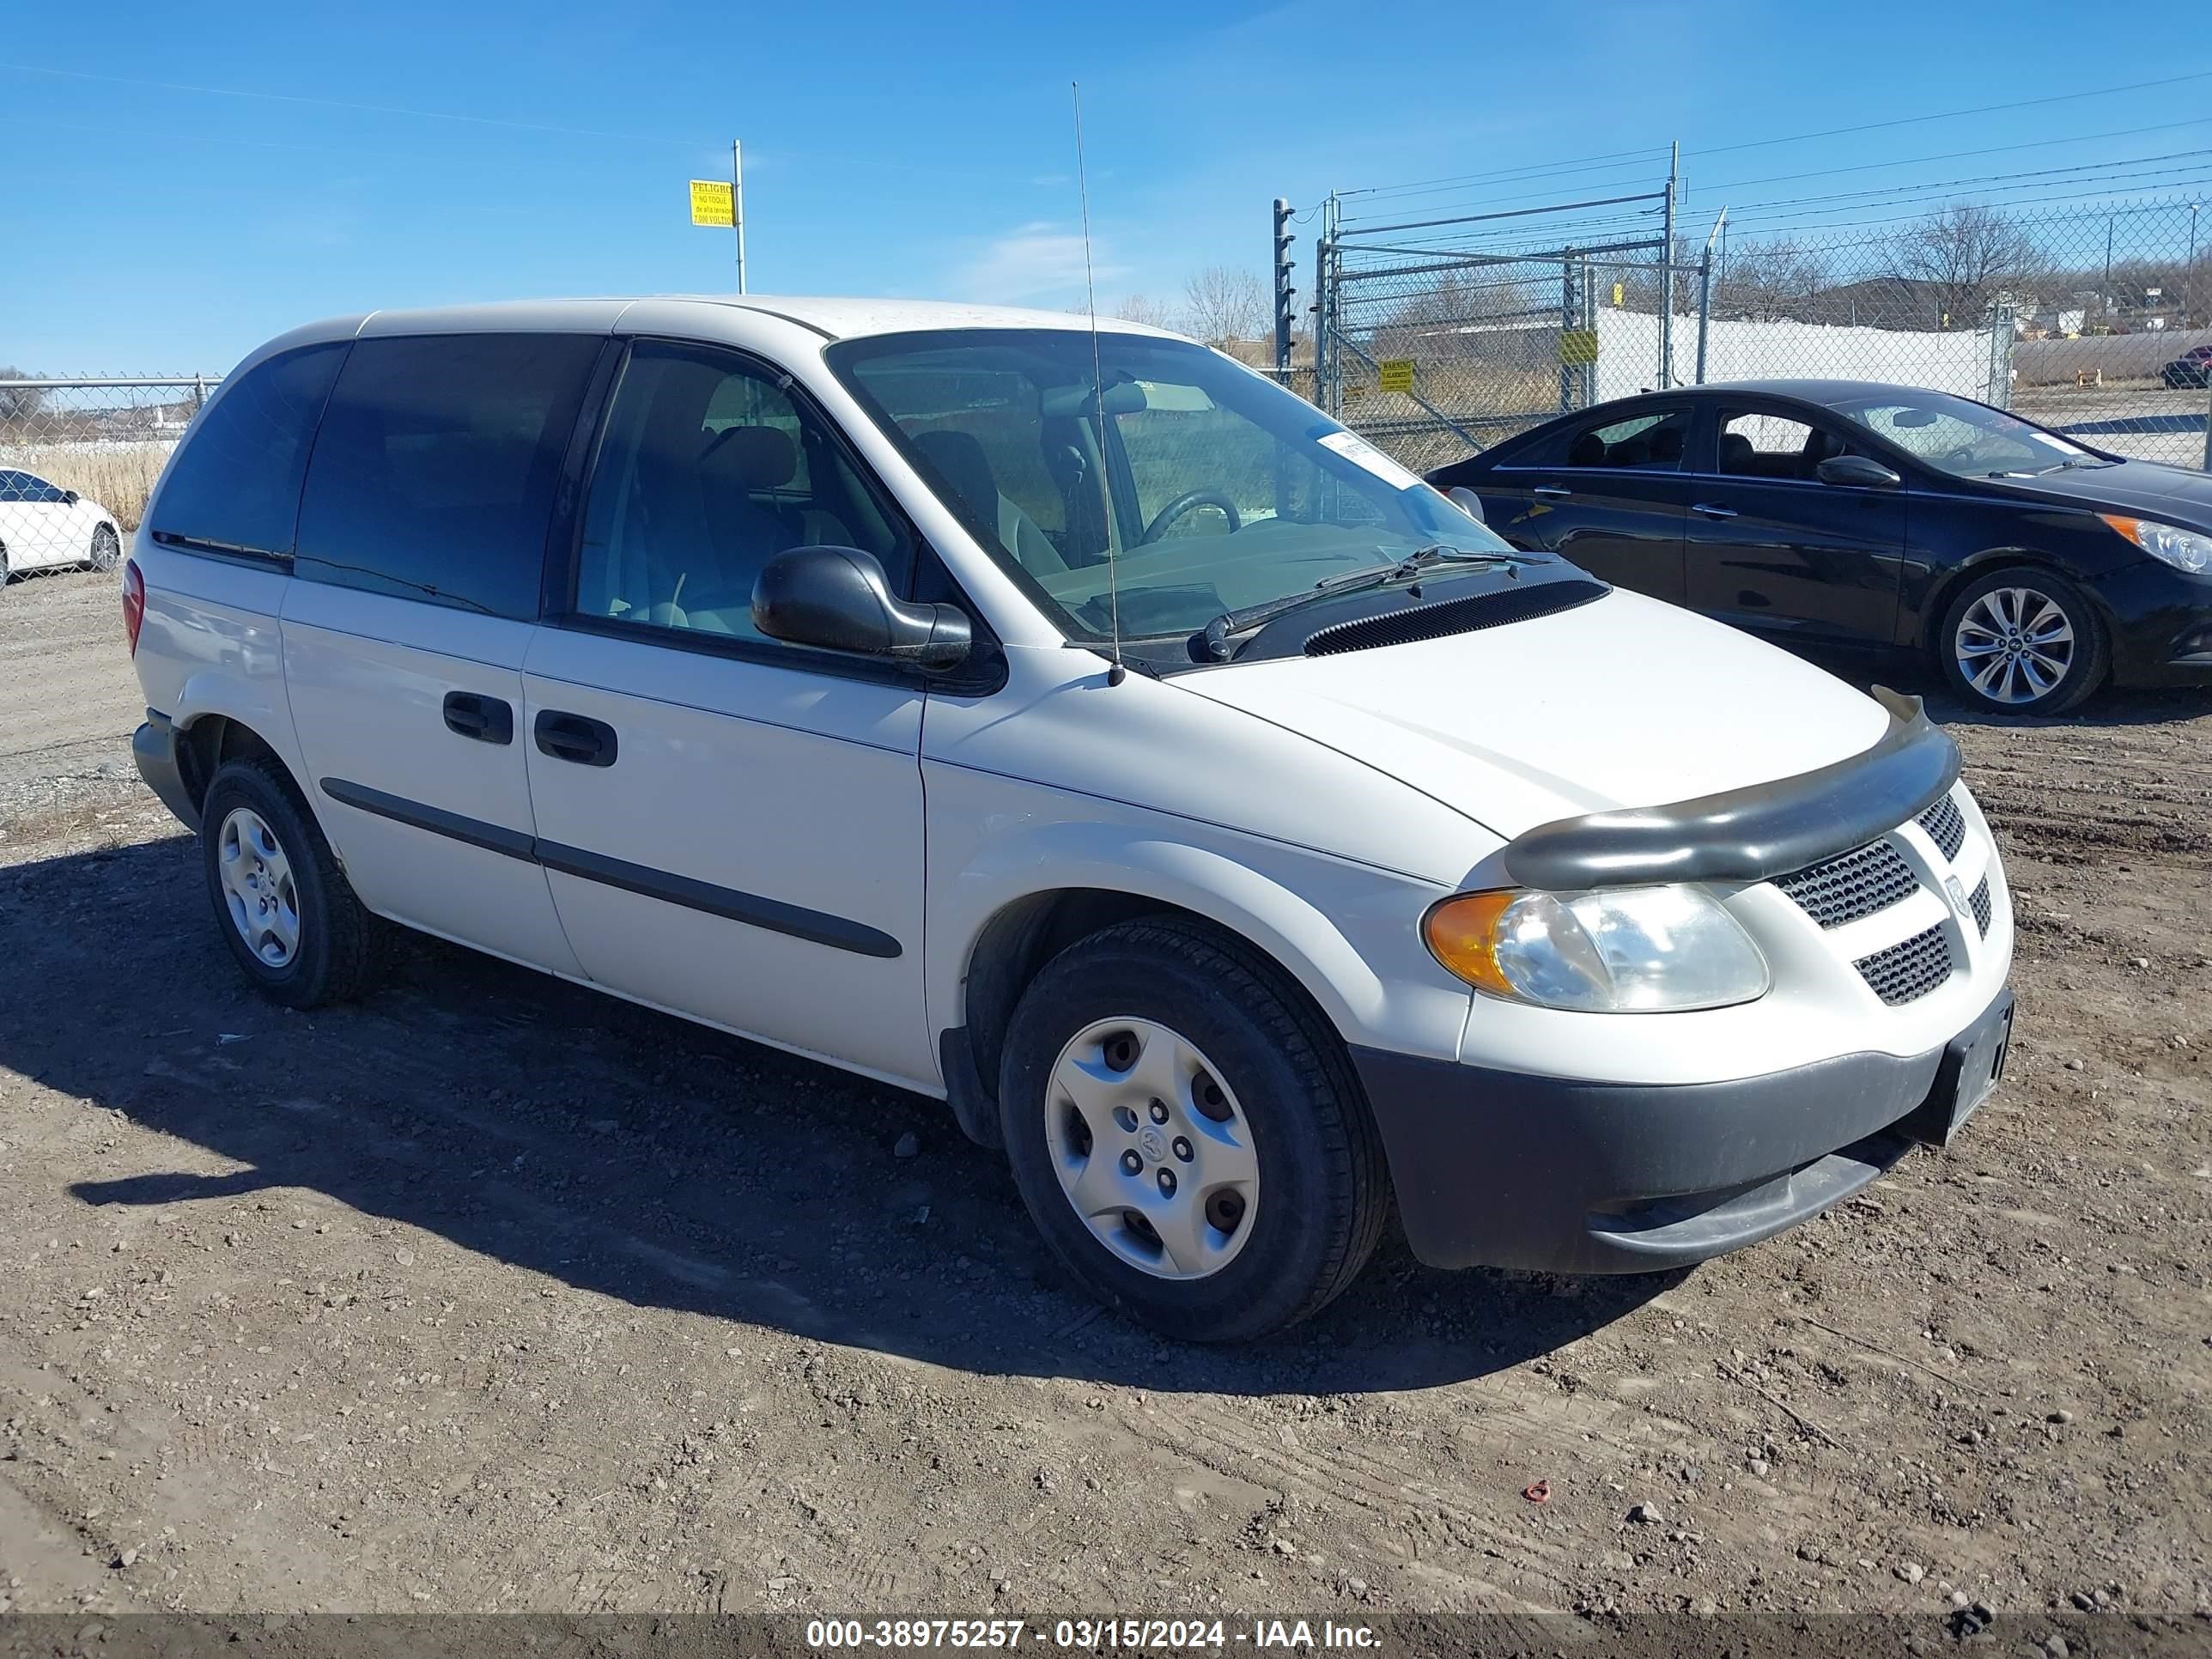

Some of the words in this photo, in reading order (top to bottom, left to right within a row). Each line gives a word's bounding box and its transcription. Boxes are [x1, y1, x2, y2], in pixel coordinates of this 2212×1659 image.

[692, 183, 732, 193] PELIGRO
[708, 196, 727, 204] TOQUE
[1382, 362, 1411, 370] WARNING
